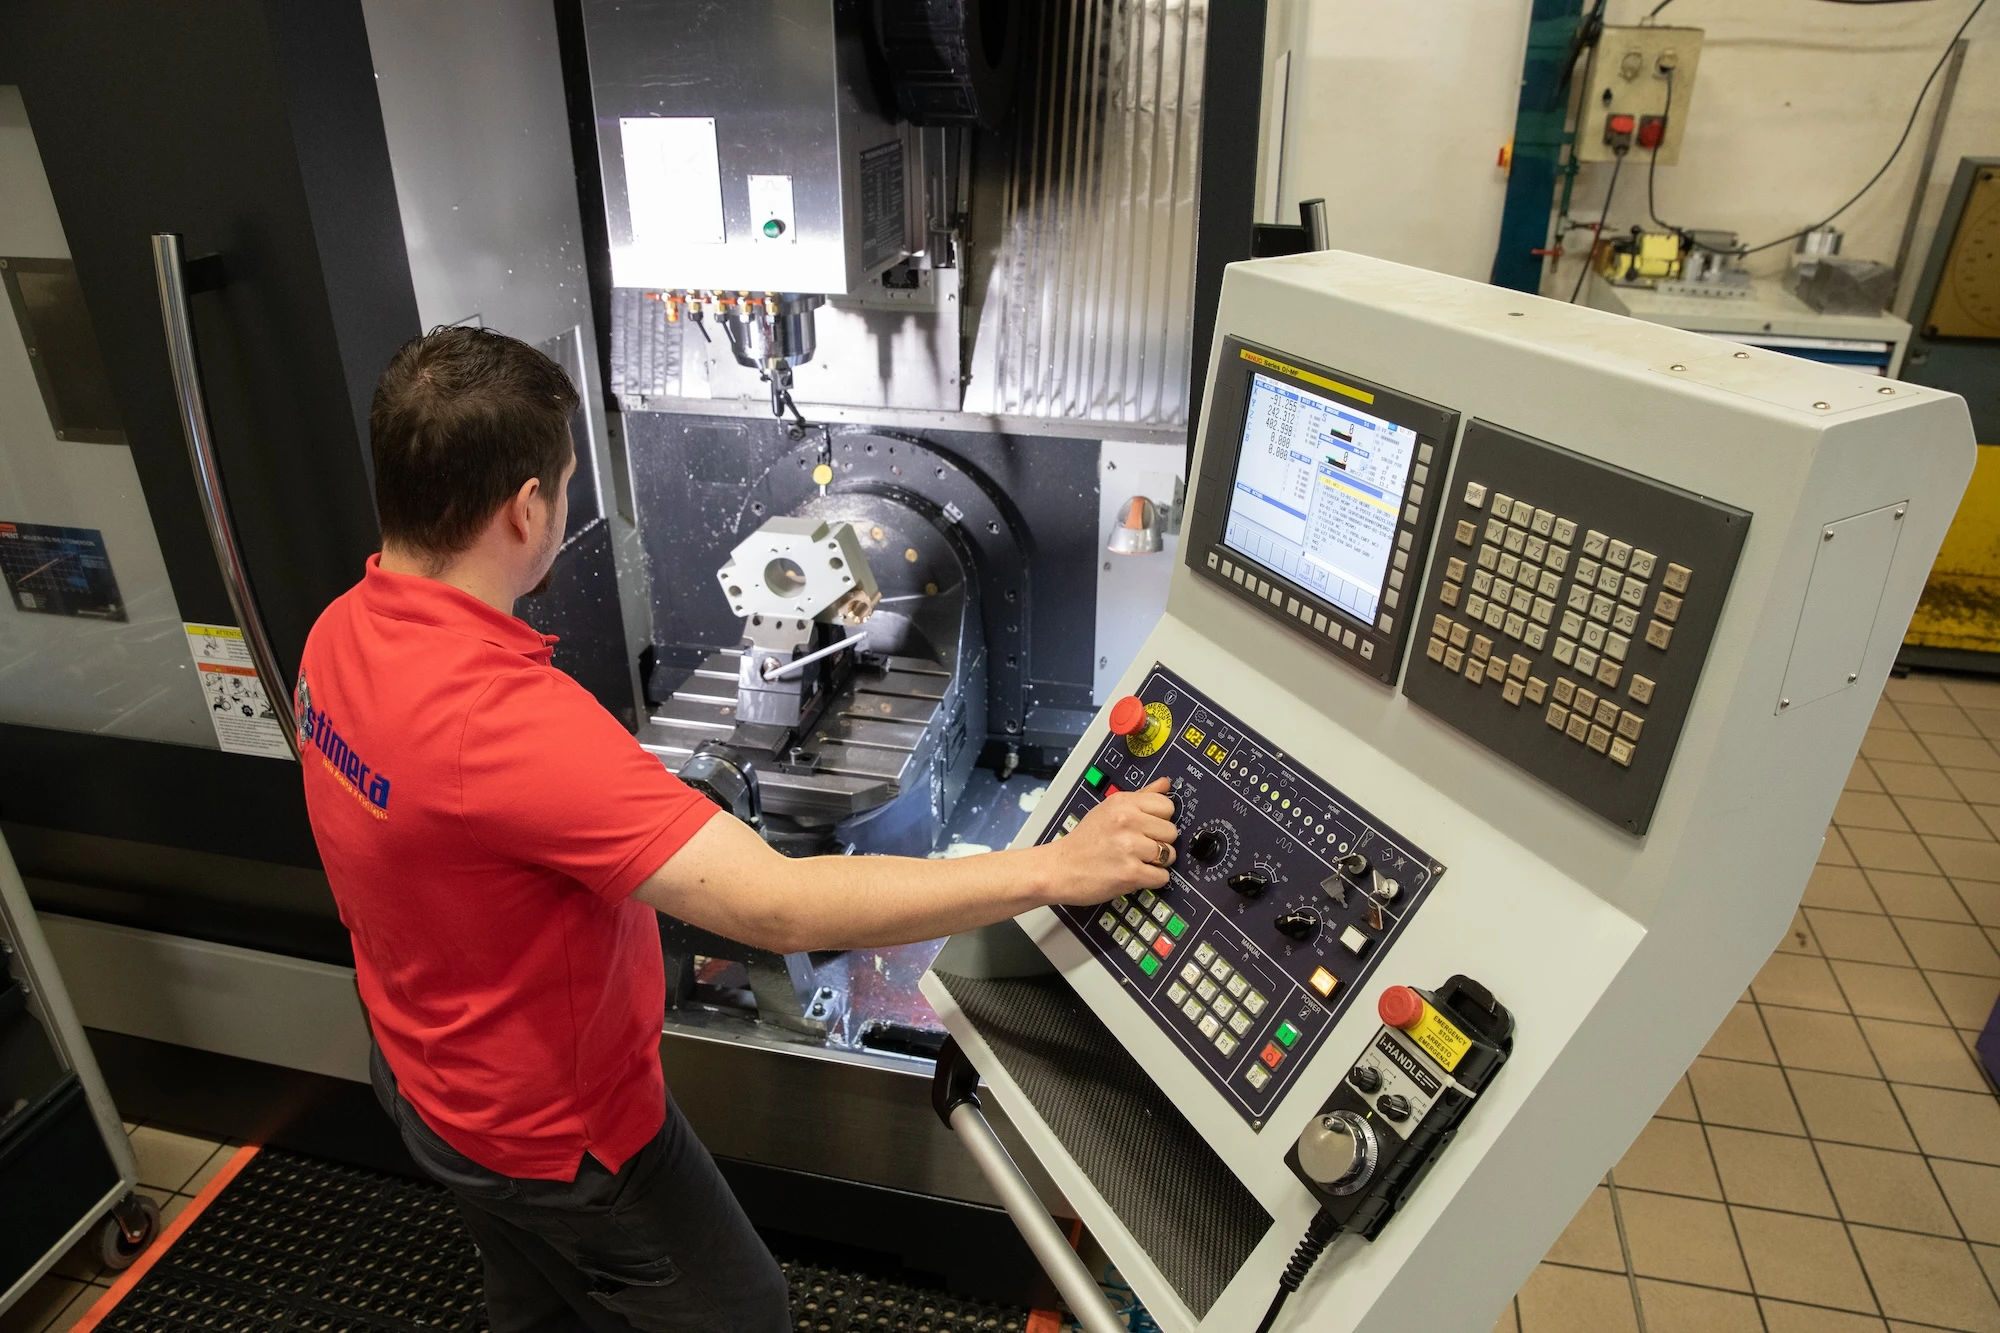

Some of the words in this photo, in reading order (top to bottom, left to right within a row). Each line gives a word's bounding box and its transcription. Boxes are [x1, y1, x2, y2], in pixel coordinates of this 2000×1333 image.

[1244, 352, 1262, 363] FANUC
[1263, 358, 1280, 370] Series
[1271, 394, 1297, 412] -91.255
[1268, 405, 1294, 424] 242.312
[1266, 418, 1292, 436] 402.998
[1270, 430, 1290, 448] 0.000
[1268, 442, 1288, 460] 0.000
[1498, 504, 1507, 515] O
[1519, 512, 1528, 522] N
[1539, 519, 1549, 531] G
[1492, 528, 1501, 540] X
[1561, 528, 1570, 540] P
[1511, 536, 1521, 549] Y
[1593, 538, 1603, 551] 7
[1532, 546, 1541, 558] Z
[1616, 548, 1626, 562] 8
[1553, 555, 1564, 568] Q
[1640, 558, 1650, 572] 9
[1505, 563, 1514, 575] J
[1585, 566, 1595, 579] 4
[1479, 579, 1488, 590] M
[1525, 573, 1534, 584] K
[1608, 577, 1618, 589] 5
[1499, 589, 1507, 599] S
[1546, 582, 1555, 594] R
[1631, 588, 1641, 600] 6
[1519, 597, 1528, 609] T
[1578, 594, 1585, 605] 1
[1473, 603, 1481, 615] F
[1539, 607, 1548, 620] L
[1600, 605, 1610, 616] 2
[1435, 620, 1447, 631] CTRL
[1492, 614, 1500, 625] D
[1623, 616, 1633, 628] 3
[1511, 624, 1520, 635] H
[1532, 633, 1540, 645] B
[1430, 644, 1439, 654] ALT
[1578, 655, 1591, 667] EOB
[1631, 689, 1645, 700] INPUT
[1152, 708, 1165, 720] STOP
[1250, 747, 1263, 758] ALARM
[1186, 763, 1204, 780] MODE
[1220, 769, 1232, 781] NC
[1281, 770, 1296, 782] STATUS
[1327, 804, 1340, 815] HOME
[1284, 819, 1293, 828] X
[1296, 828, 1304, 837] Y
[1306, 836, 1315, 846] Z
[1318, 845, 1327, 855] 4
[1169, 870, 1190, 894] FUNCTION
[1236, 901, 1246, 915] %
[1324, 934, 1332, 944] 110
[1240, 938, 1261, 960] MANUAL
[1282, 943, 1294, 957] %
[1315, 947, 1323, 957] 120
[1301, 993, 1321, 1014] POWER
[1434, 1016, 1467, 1046] EMERGENCY
[1438, 1030, 1454, 1044] STOP
[1219, 1037, 1228, 1050] F1
[1426, 1034, 1452, 1057] ARRESTO
[1418, 1036, 1451, 1067] EMERGENZA
[1379, 1036, 1428, 1080] i-HANDLE
